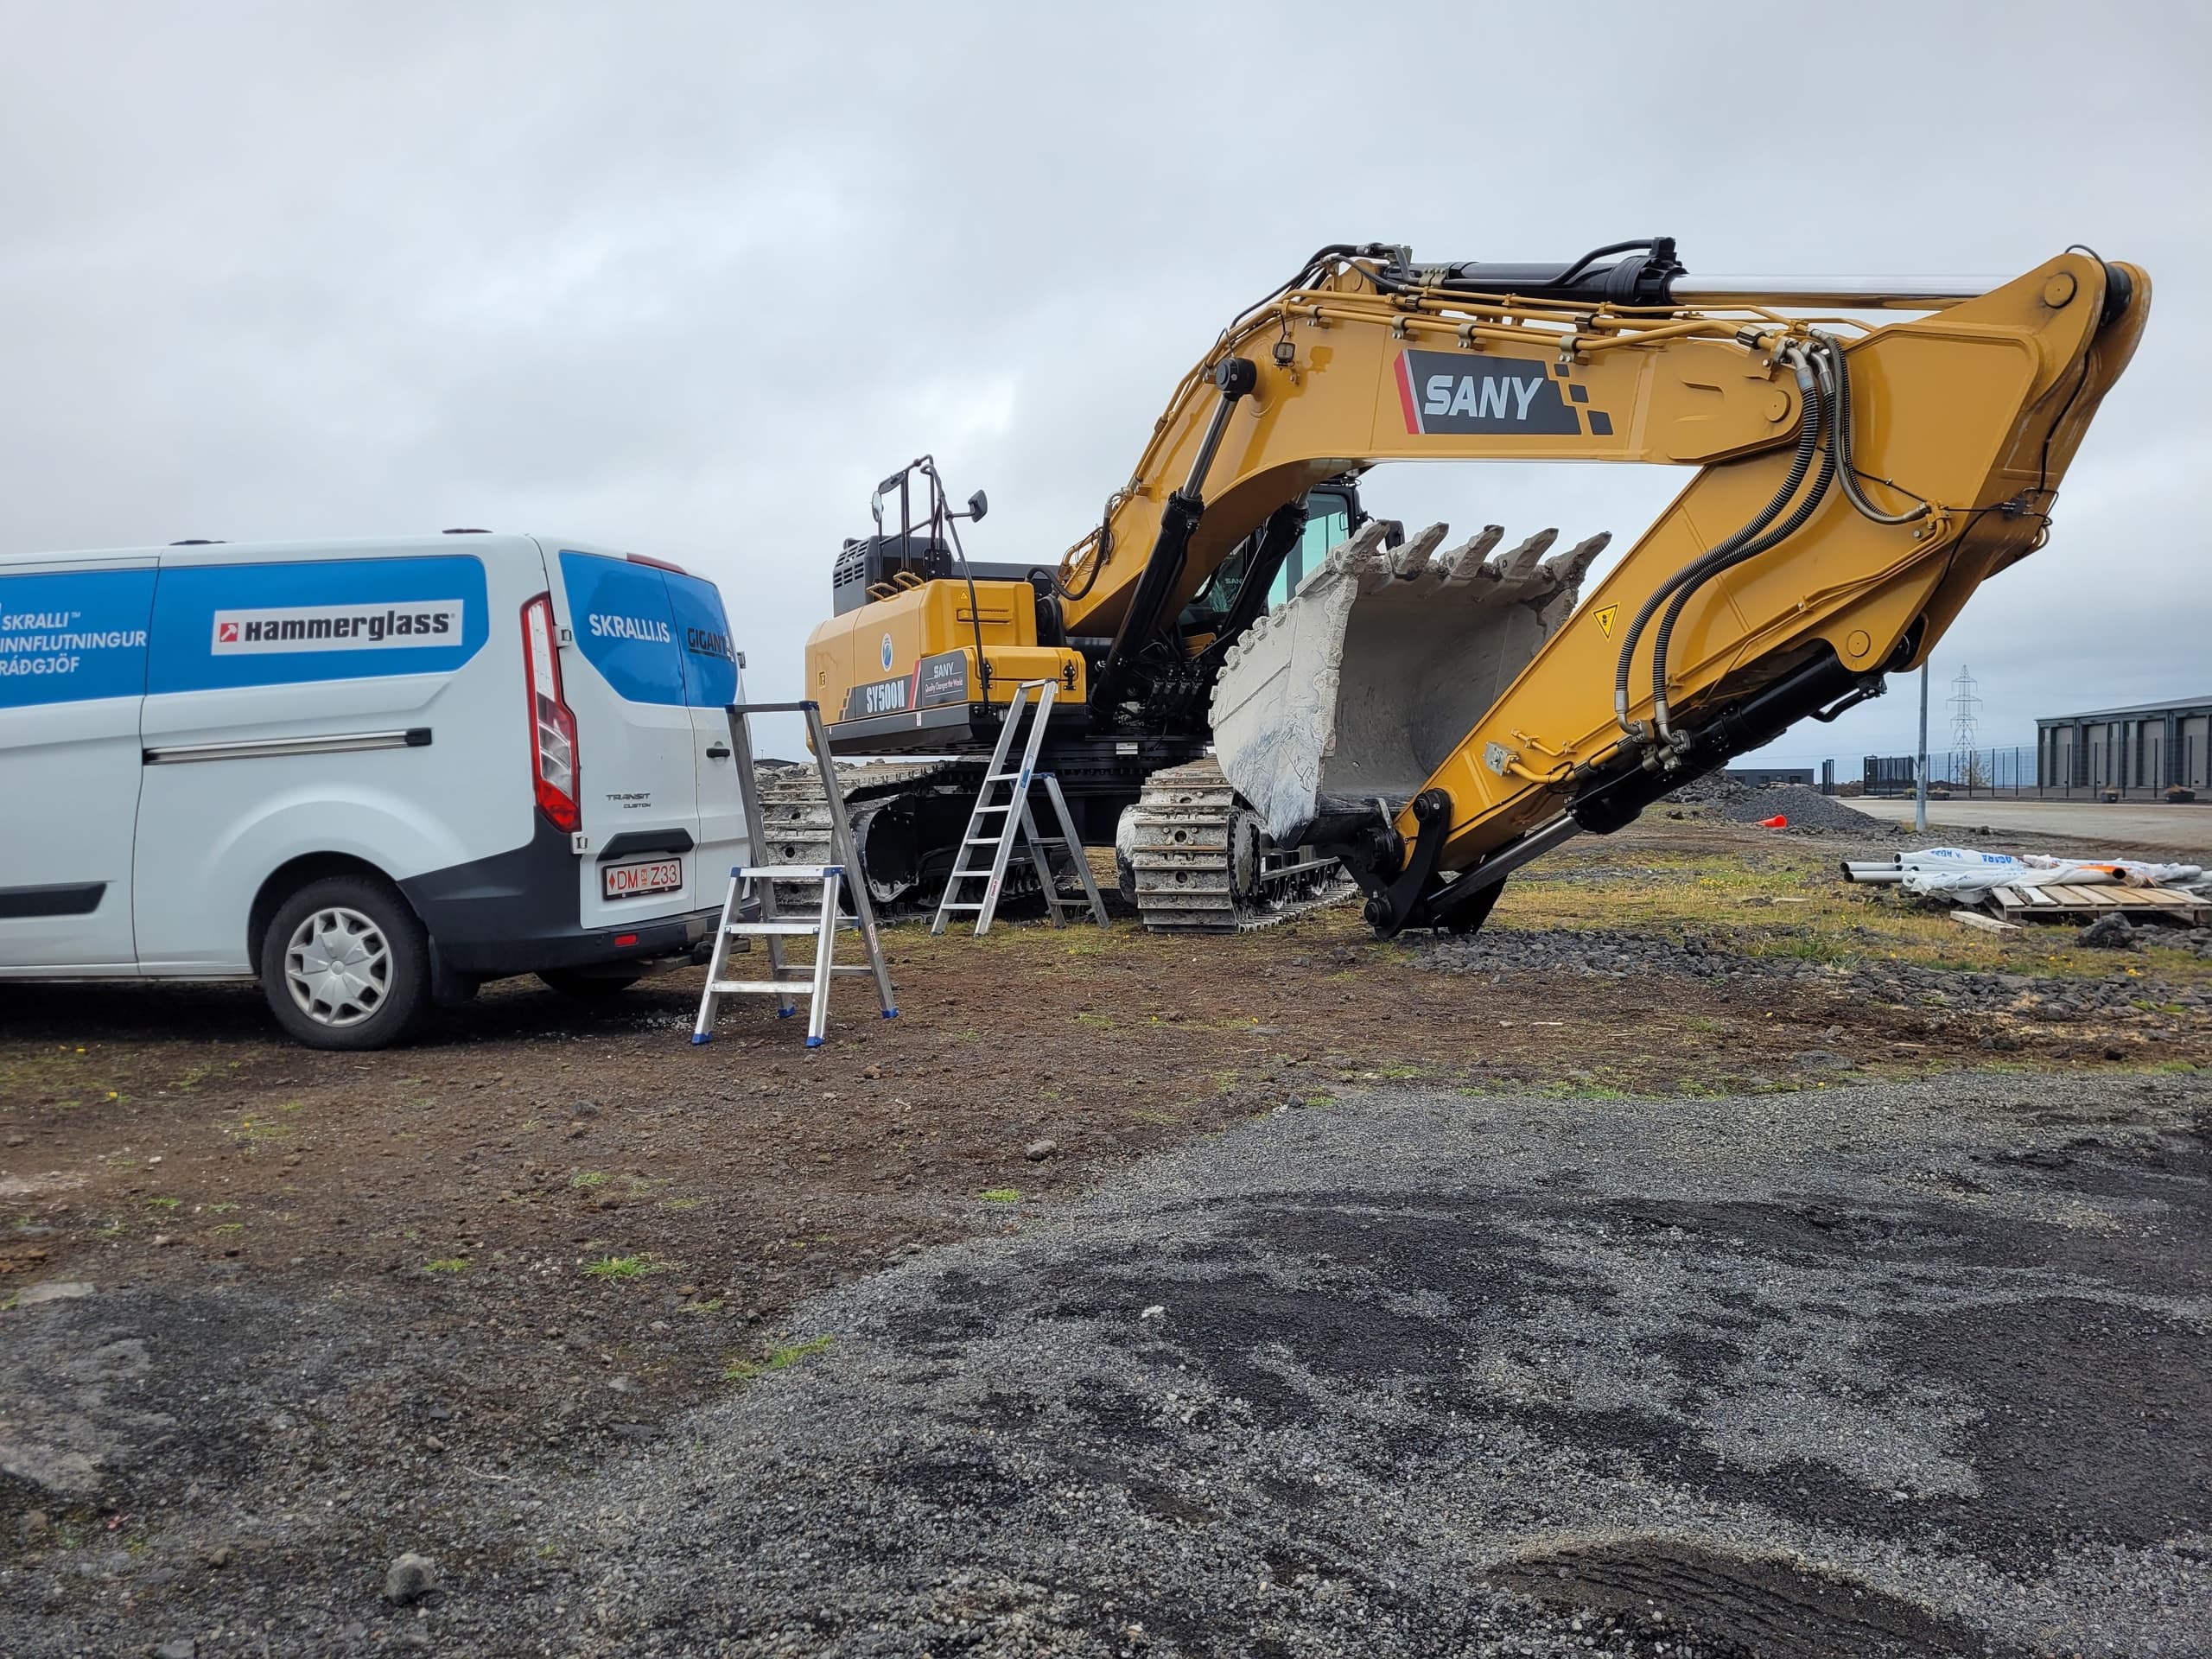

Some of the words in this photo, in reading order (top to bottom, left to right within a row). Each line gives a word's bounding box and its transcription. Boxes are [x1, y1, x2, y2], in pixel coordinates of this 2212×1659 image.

[1424, 374, 1544, 420] SANY
[245, 610, 449, 641] Hammerglass
[588, 613, 671, 644] SKRALLI.IS
[0, 630, 147, 653] INNFLUTNINGUR
[934, 662, 953, 678] SANY
[617, 869, 638, 890] DM
[651, 864, 677, 886] Z33
